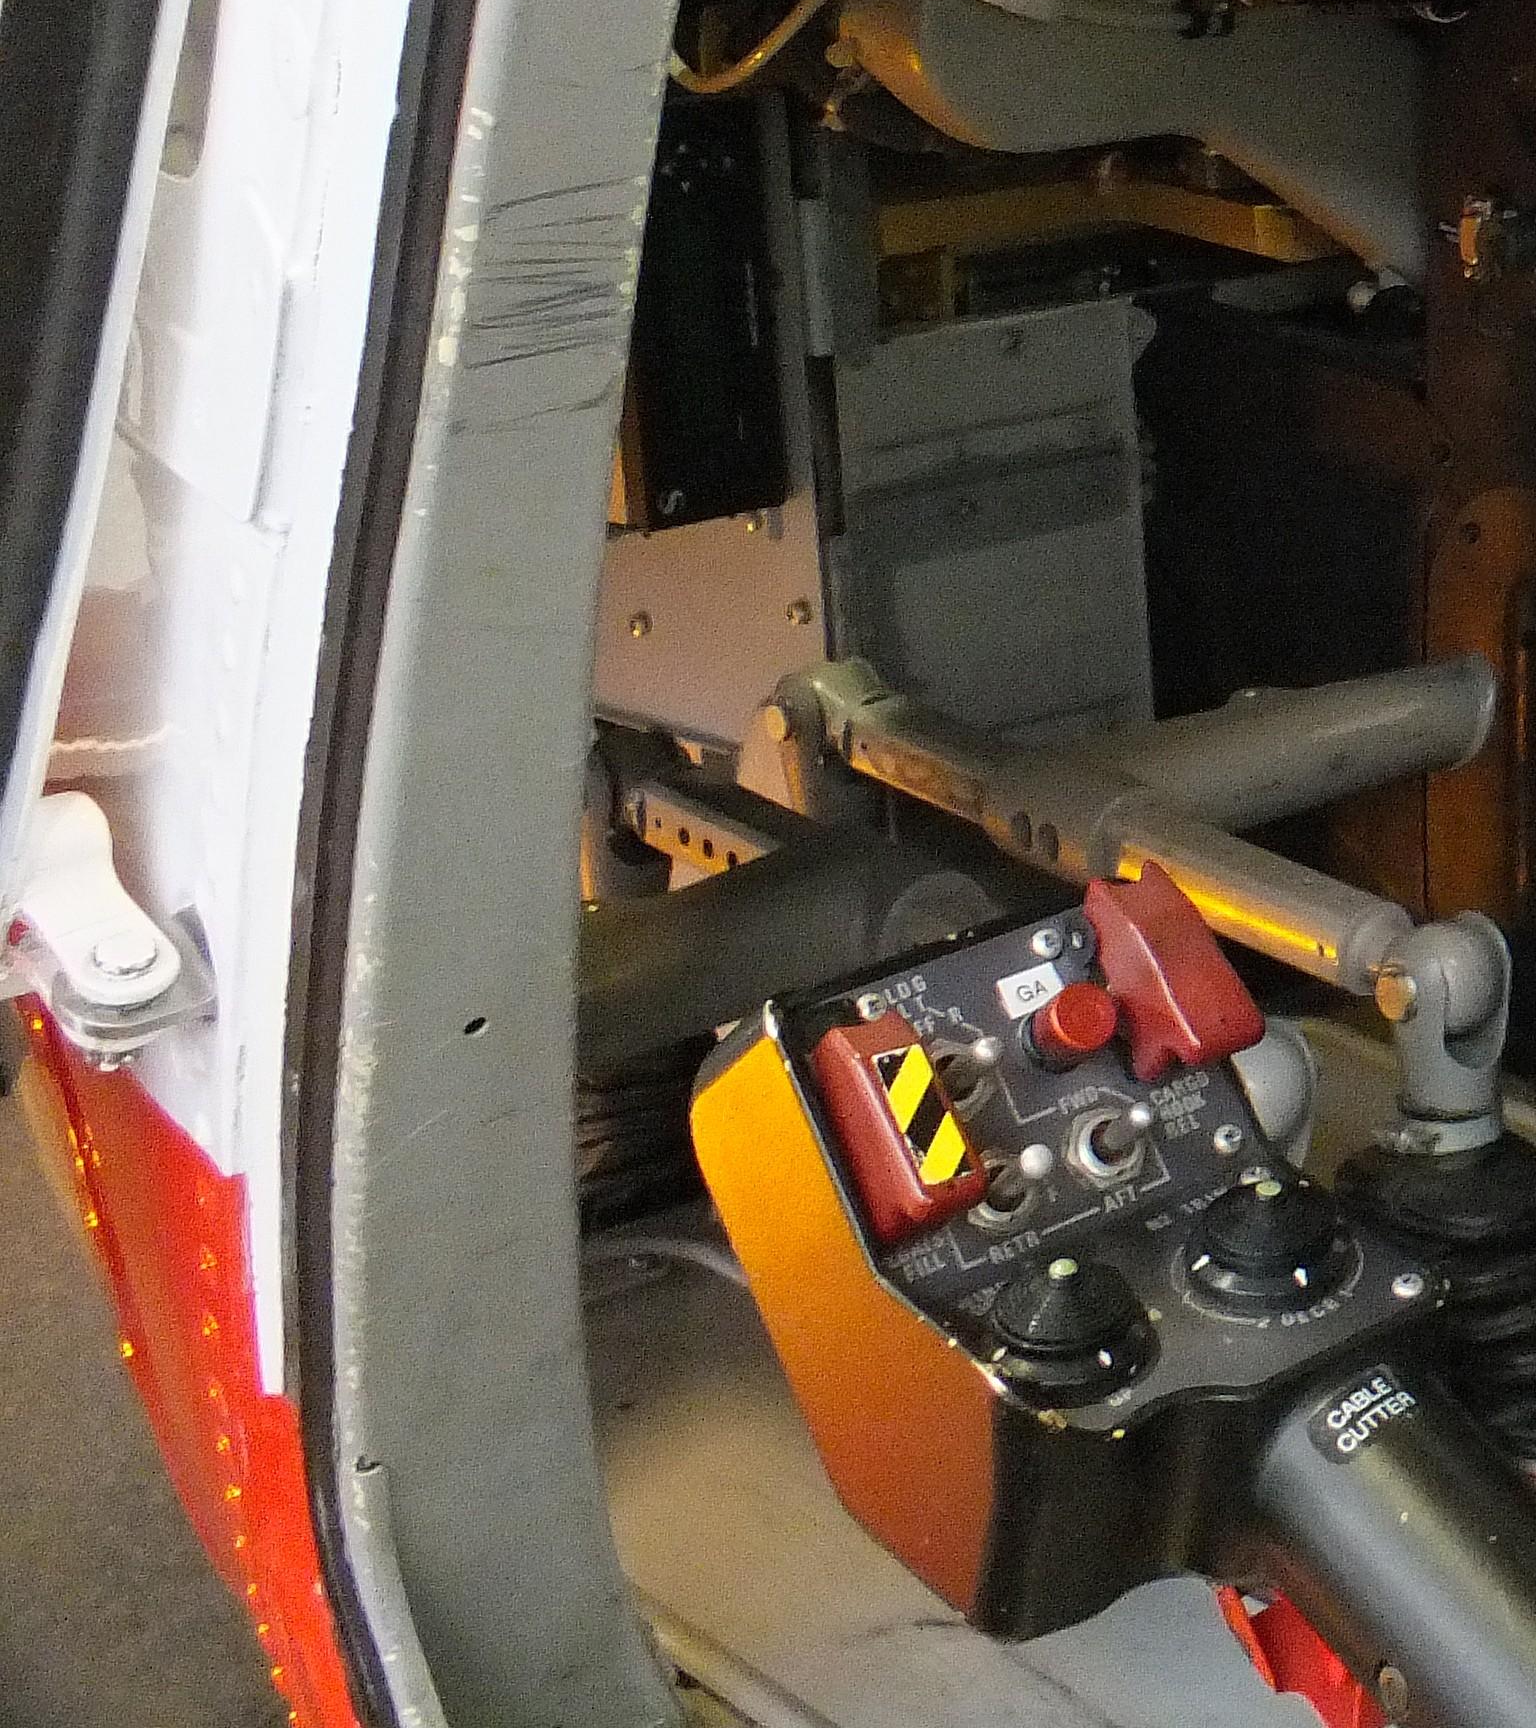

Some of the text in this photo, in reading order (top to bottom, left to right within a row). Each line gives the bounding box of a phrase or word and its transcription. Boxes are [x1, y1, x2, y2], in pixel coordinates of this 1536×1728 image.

[884, 974, 928, 1003] LDG
[1016, 980, 1048, 1002] GA
[1058, 1085, 1099, 1114] FWD
[1150, 1071, 1210, 1106] CARGO
[1103, 1184, 1138, 1213] AFT
[1327, 1376, 1393, 1429] CABLE
[1336, 1391, 1417, 1453] CUTTER
